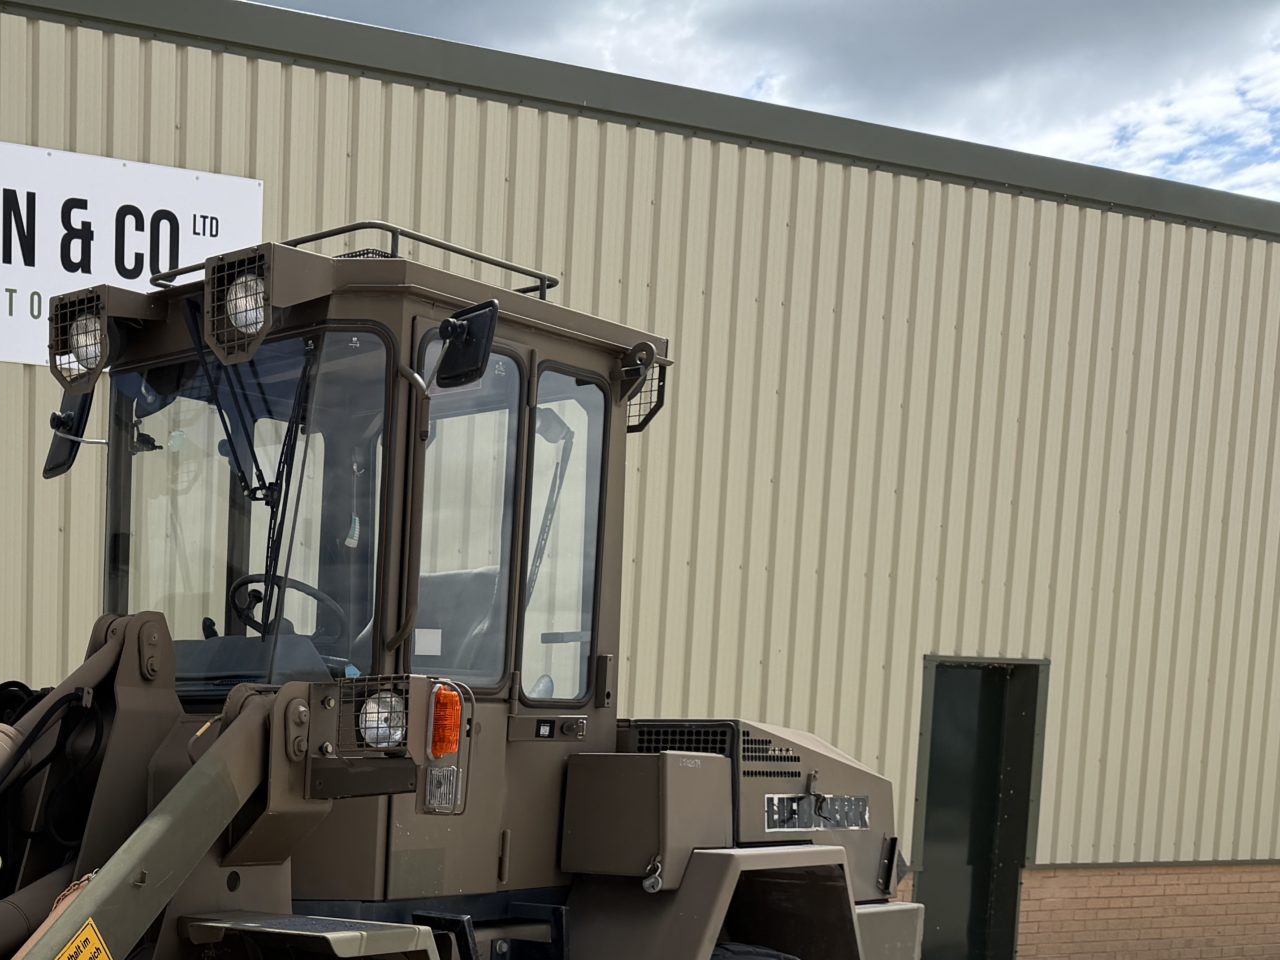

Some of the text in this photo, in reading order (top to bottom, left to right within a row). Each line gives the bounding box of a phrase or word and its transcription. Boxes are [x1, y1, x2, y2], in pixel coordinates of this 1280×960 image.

[60, 197, 94, 275] &
[114, 204, 180, 284] CO
[192, 213, 219, 238] LTD
[80, 937, 91, 950] im
